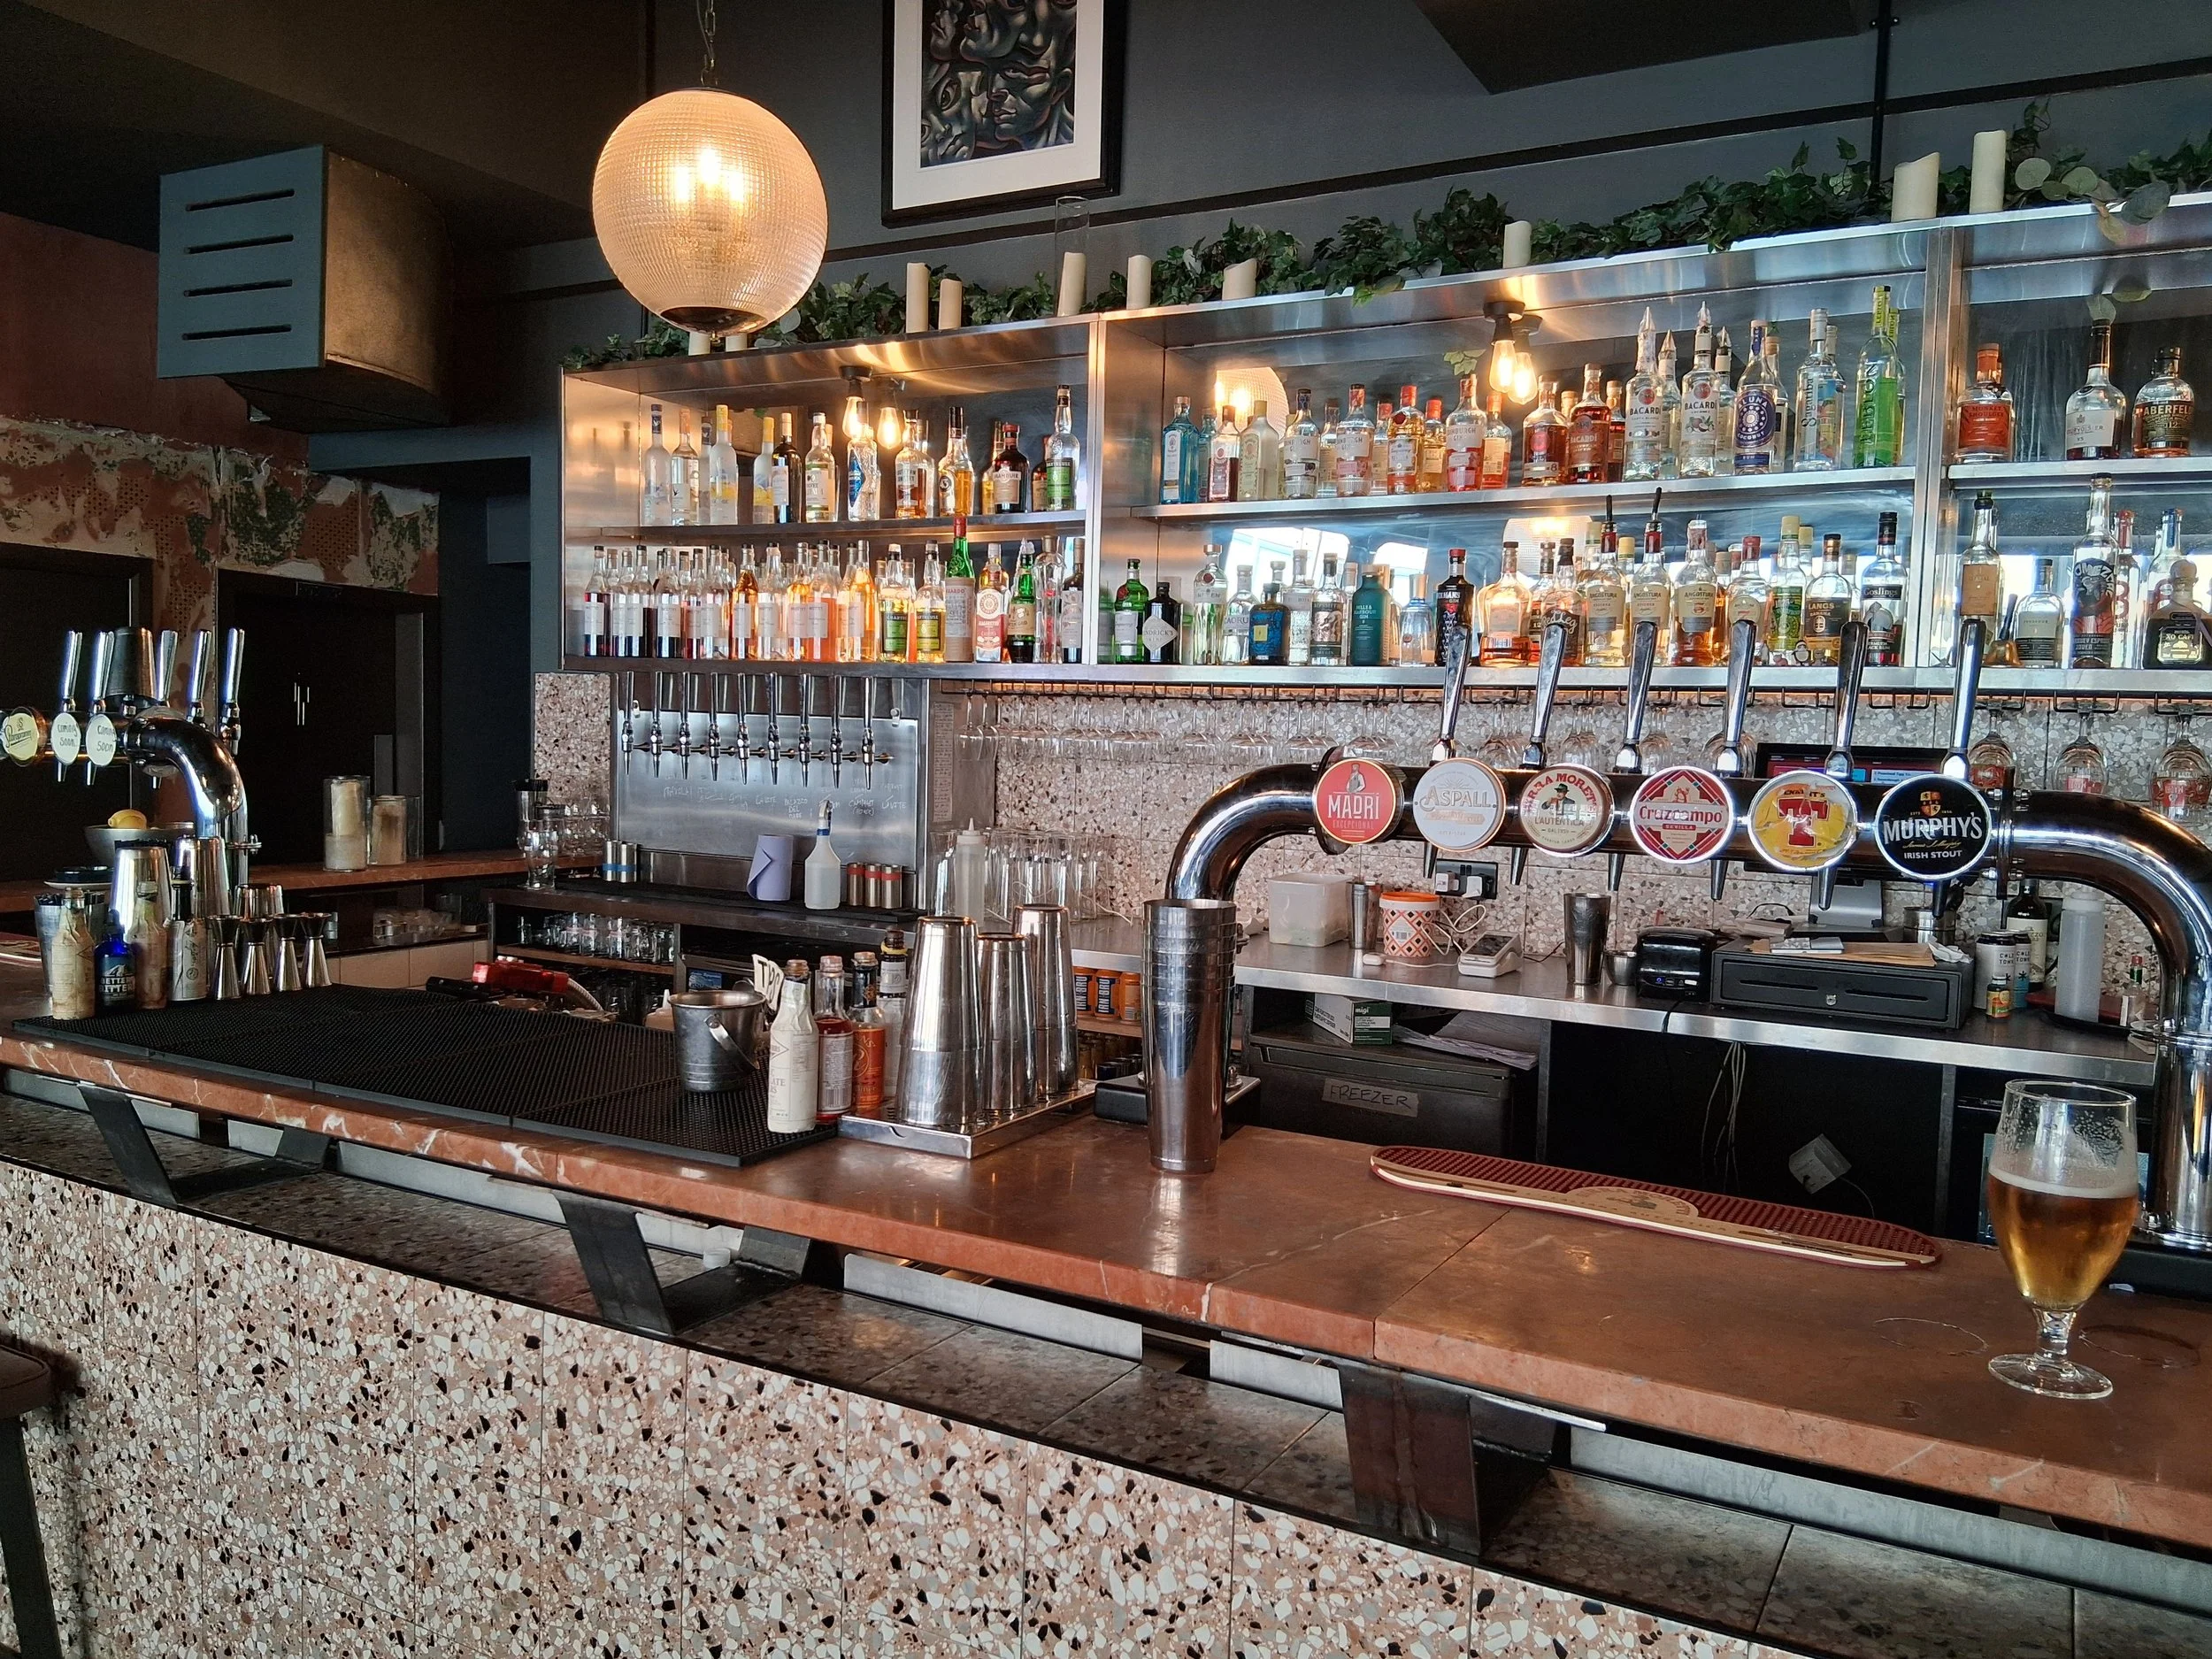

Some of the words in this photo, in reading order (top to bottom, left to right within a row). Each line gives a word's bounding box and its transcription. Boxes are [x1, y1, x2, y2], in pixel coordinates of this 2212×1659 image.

[1738, 396, 1768, 409] ALUNA
[1864, 588, 1899, 596] Goslings
[1420, 786, 1492, 812] ASPALL
[1640, 805, 1723, 825] Cruzcampo
[1333, 820, 1374, 829] EXCEPCIONAL
[1883, 812, 1982, 845] MURPHY'S
[1931, 850, 1963, 859] STOUT
[1330, 1085, 1412, 1110] FREEZER
